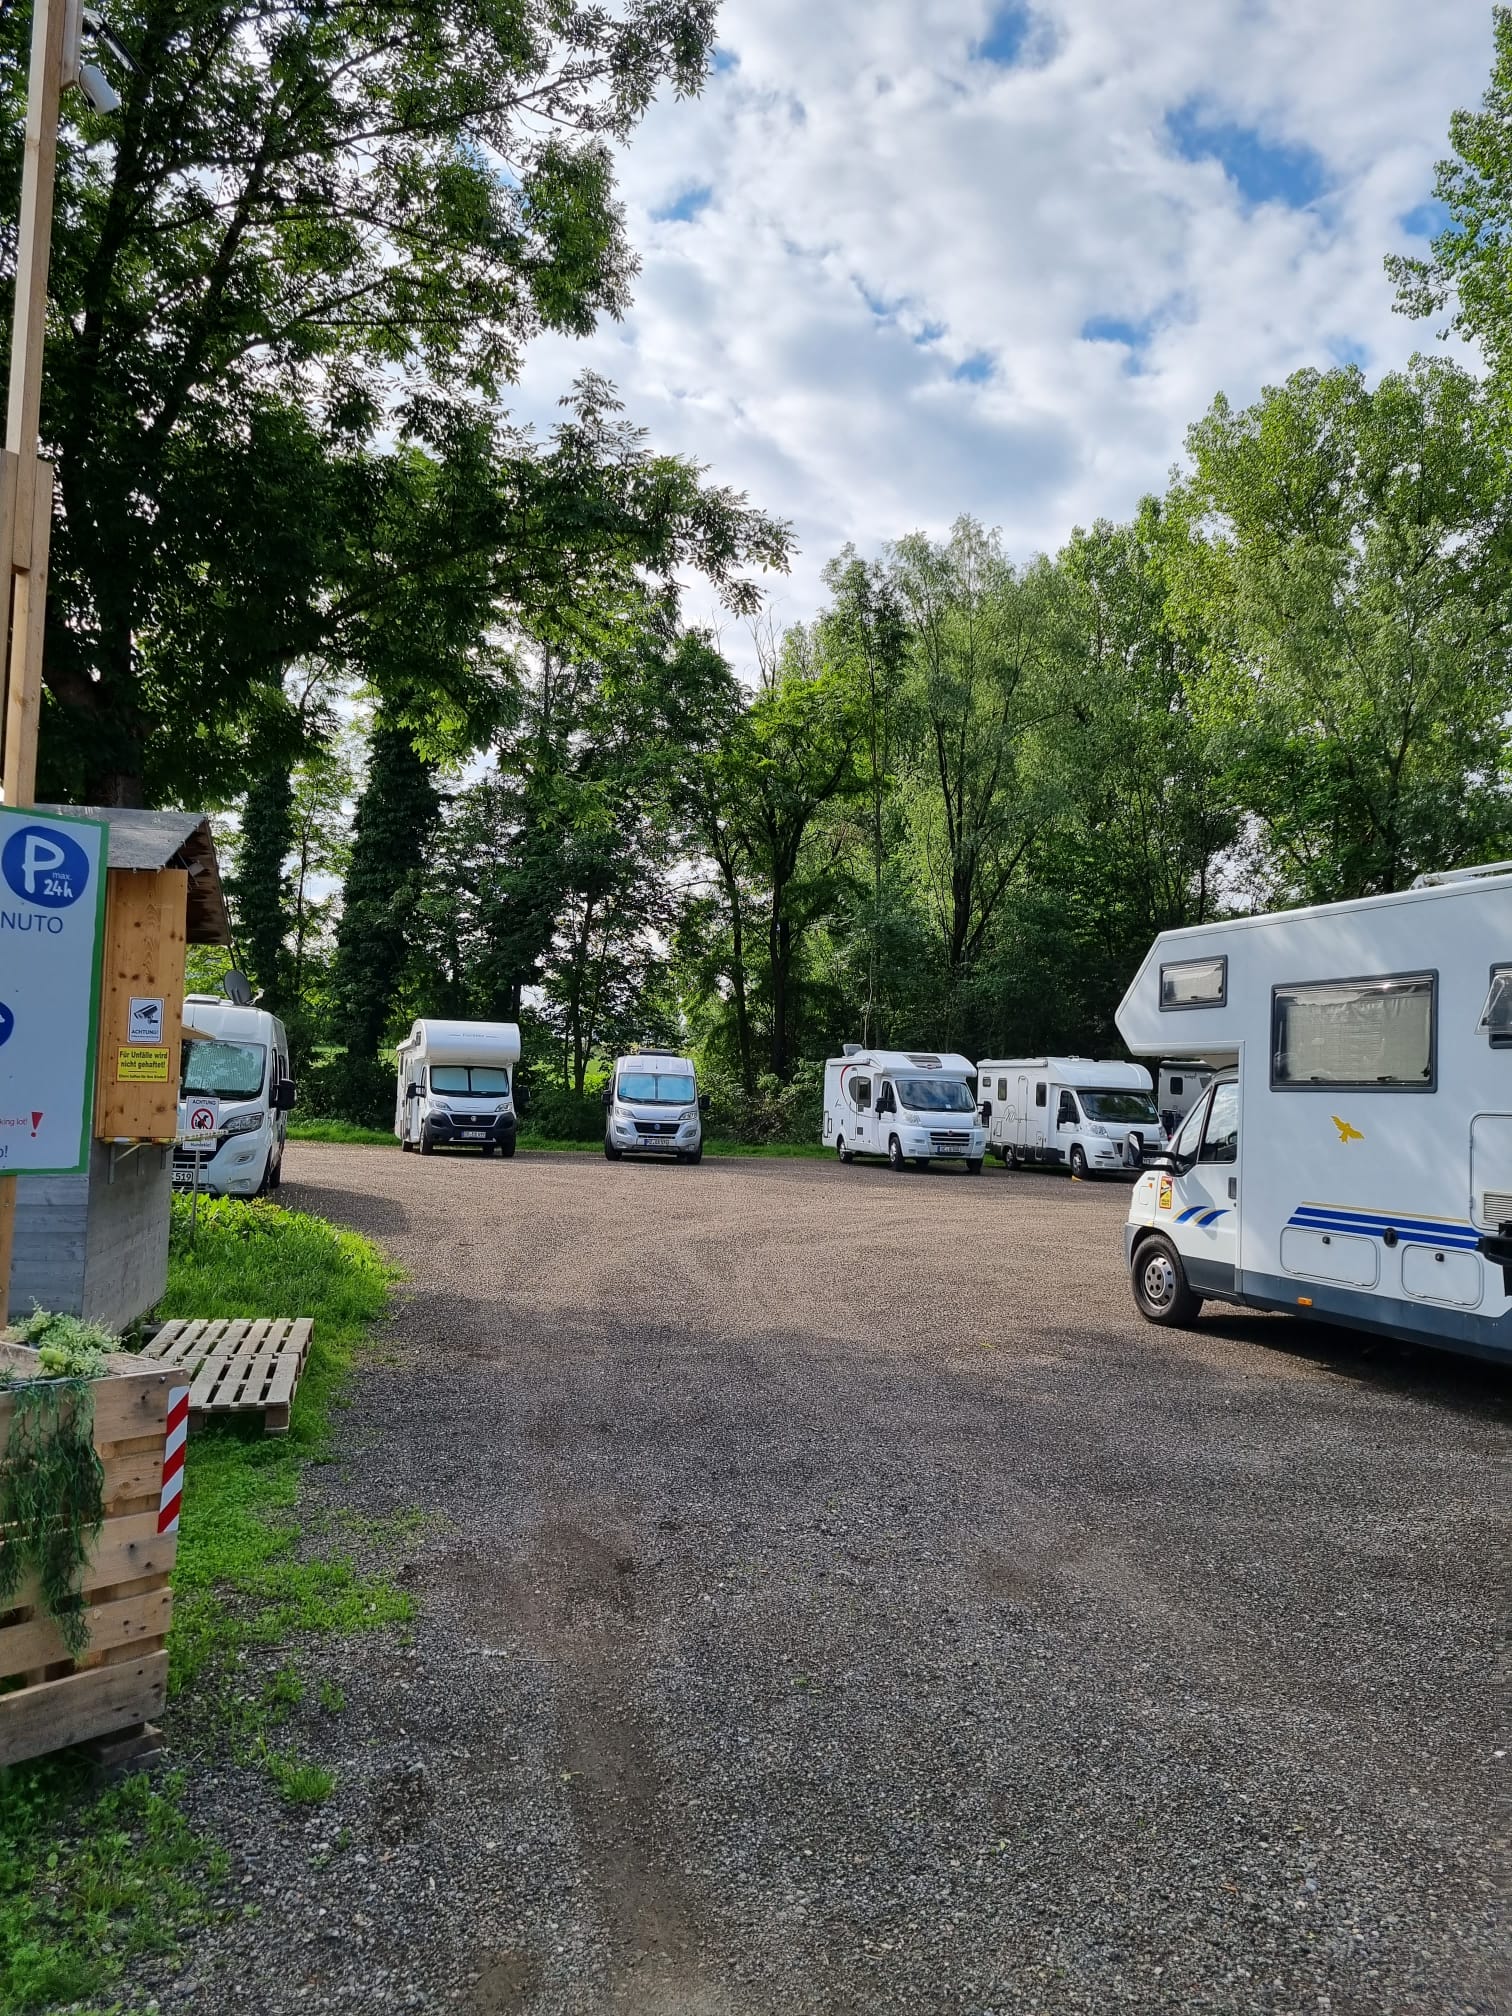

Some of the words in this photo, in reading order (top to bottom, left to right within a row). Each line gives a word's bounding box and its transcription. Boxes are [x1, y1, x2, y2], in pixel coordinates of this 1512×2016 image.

[21, 834, 65, 894] P
[52, 872, 73, 881] max.
[43, 878, 73, 898] 24h
[154, 1051, 168, 1060] wird
[175, 1172, 192, 1181] 519
